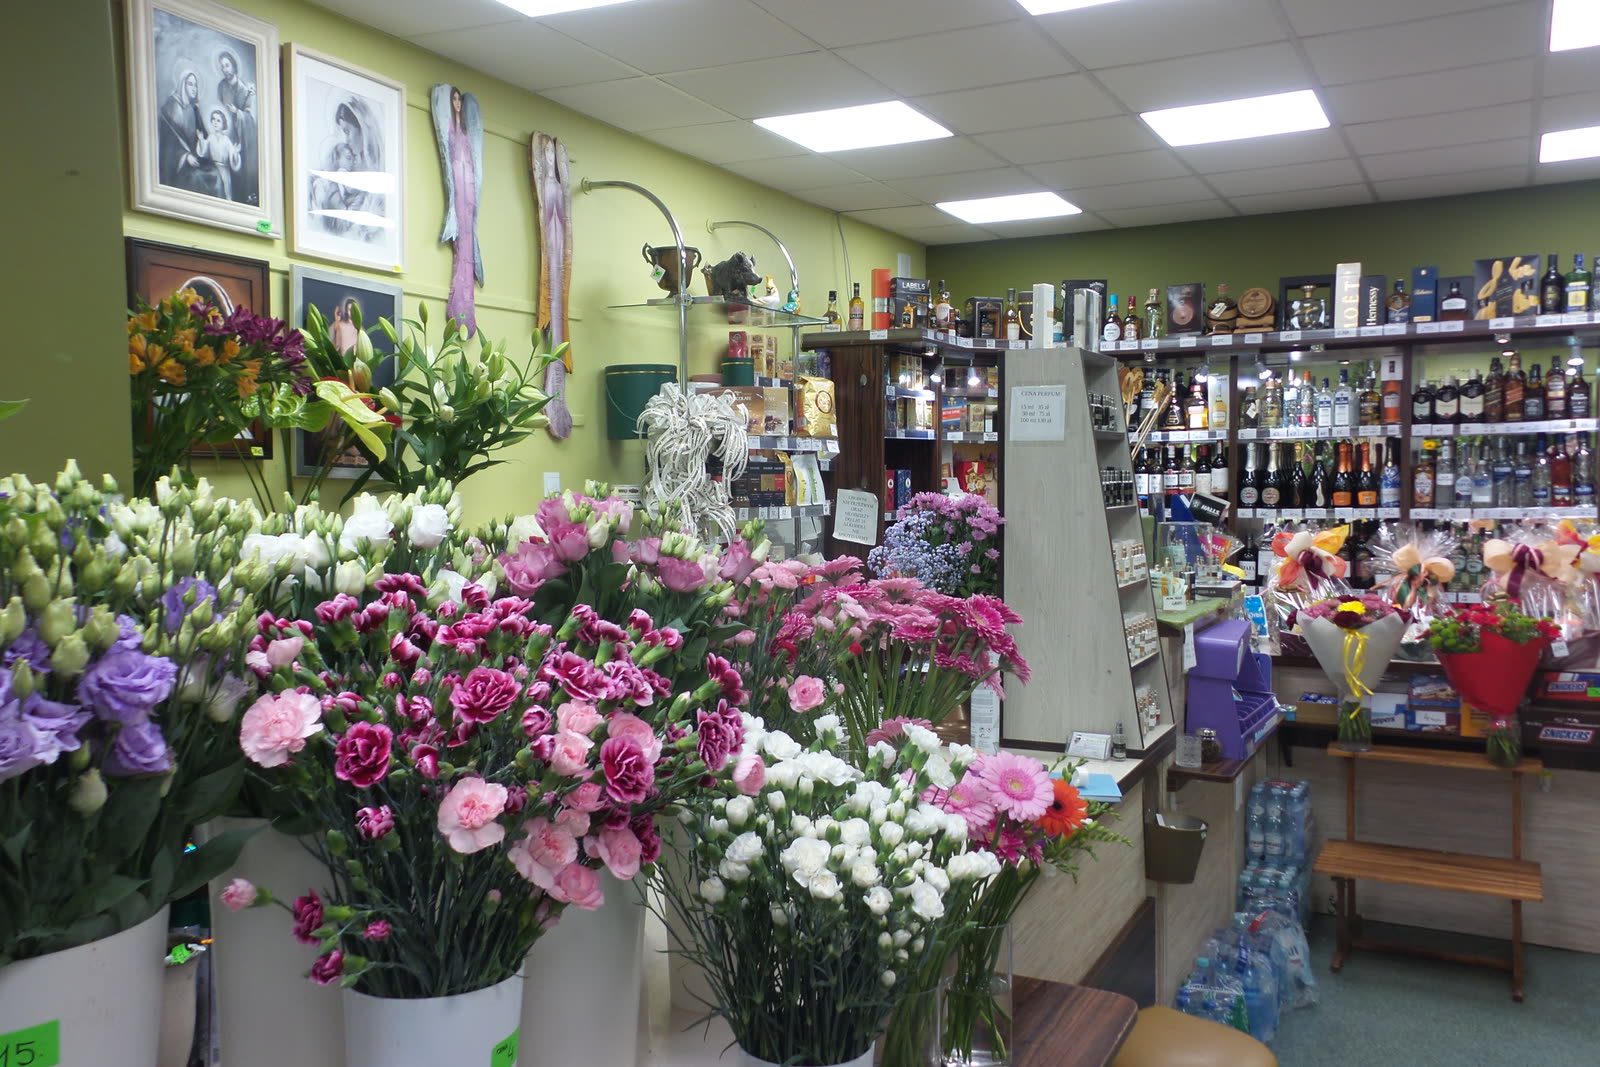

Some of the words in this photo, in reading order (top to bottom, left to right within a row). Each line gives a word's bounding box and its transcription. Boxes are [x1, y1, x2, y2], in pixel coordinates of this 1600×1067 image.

[1366, 286, 1379, 326] Hennessy
[1201, 503, 1220, 515] HALLS
[1550, 683, 1586, 691] SNICKERS
[1542, 728, 1591, 741] SNICKERS
